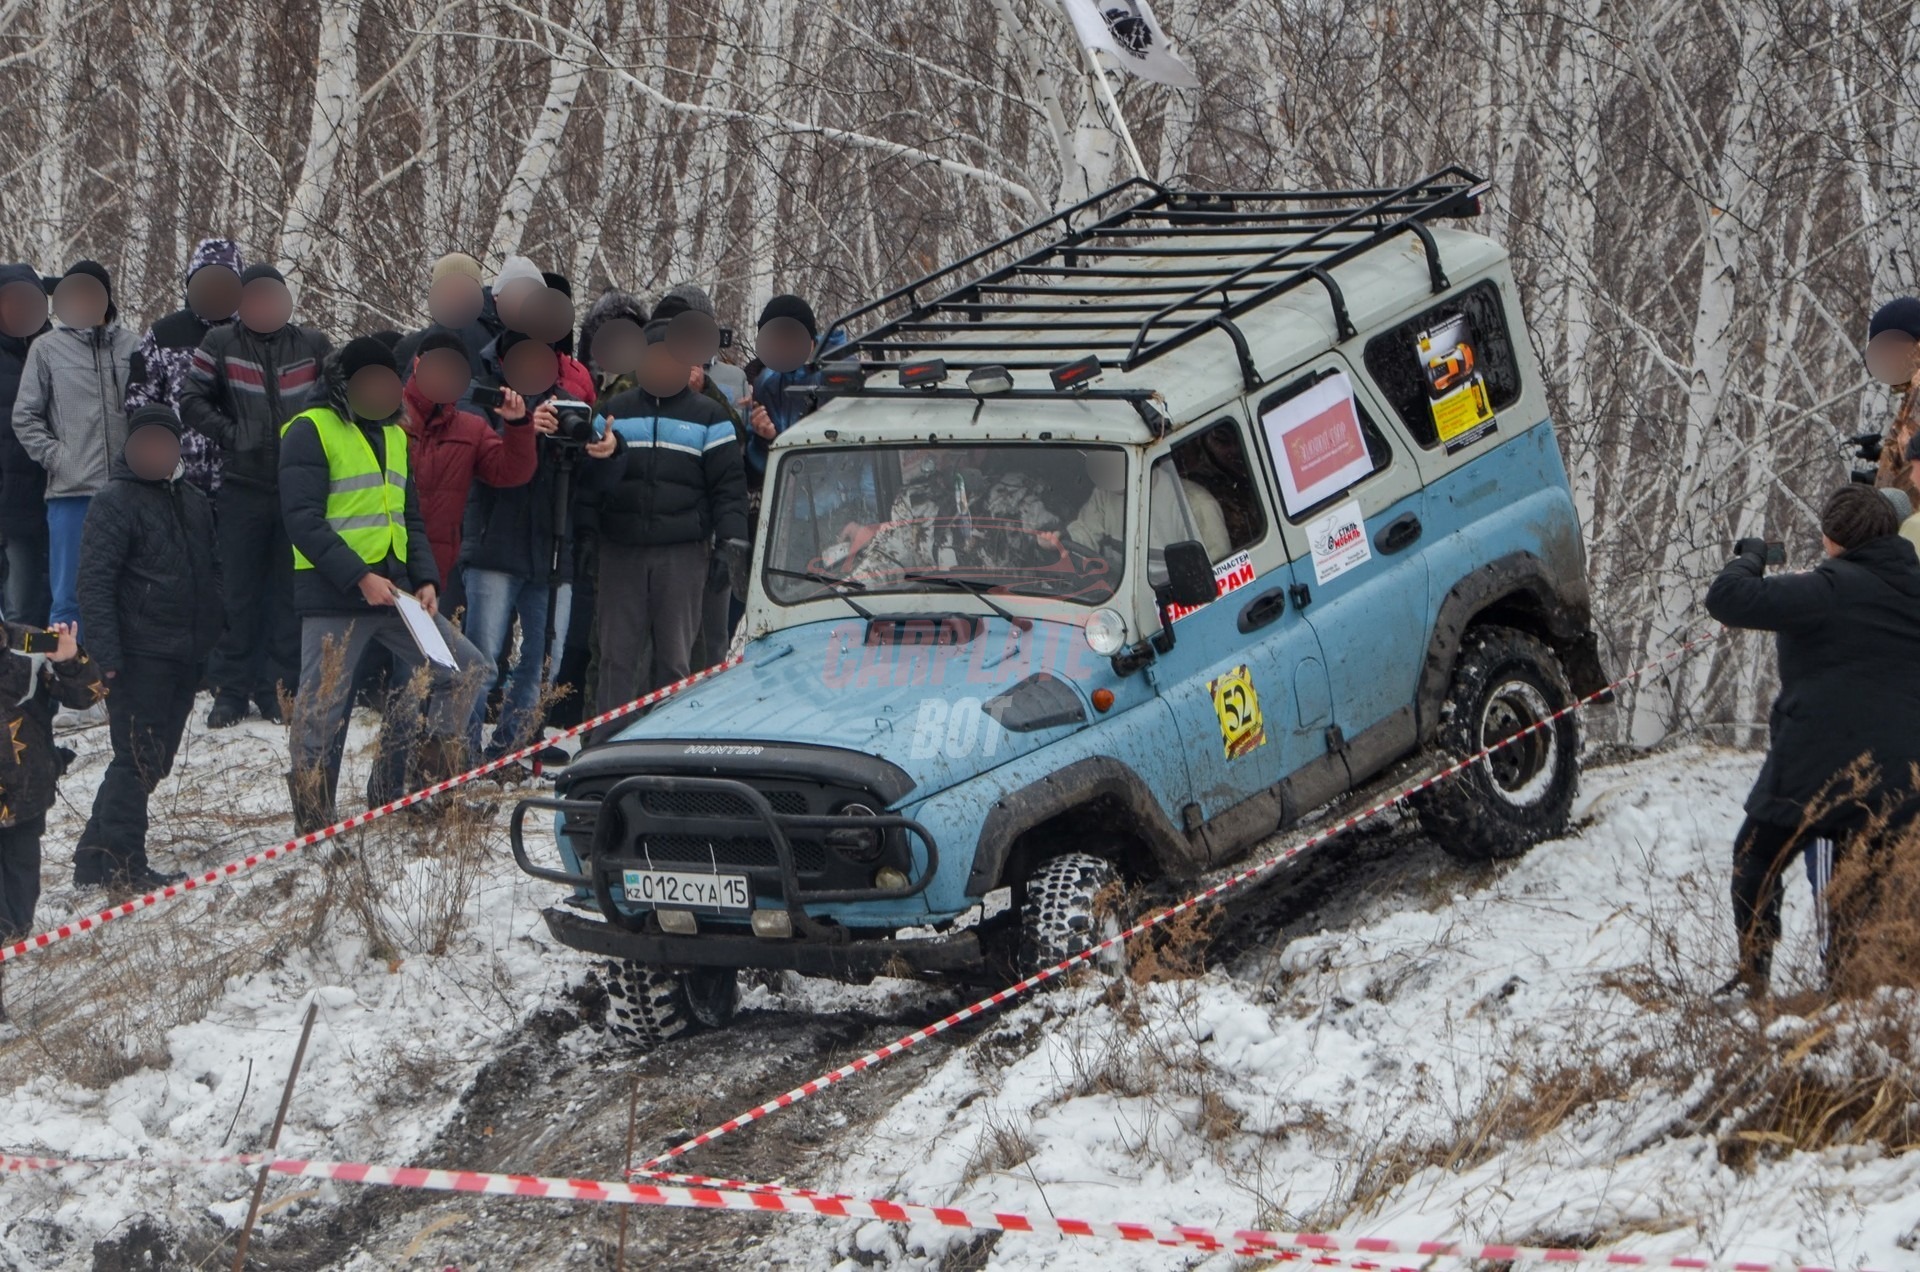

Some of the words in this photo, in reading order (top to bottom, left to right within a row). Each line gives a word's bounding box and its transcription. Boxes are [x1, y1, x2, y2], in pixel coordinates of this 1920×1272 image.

[1223, 684, 1253, 732] 52
[684, 745, 764, 755] HUNTER
[626, 888, 641, 899] KZ
[723, 880, 747, 904] 15
